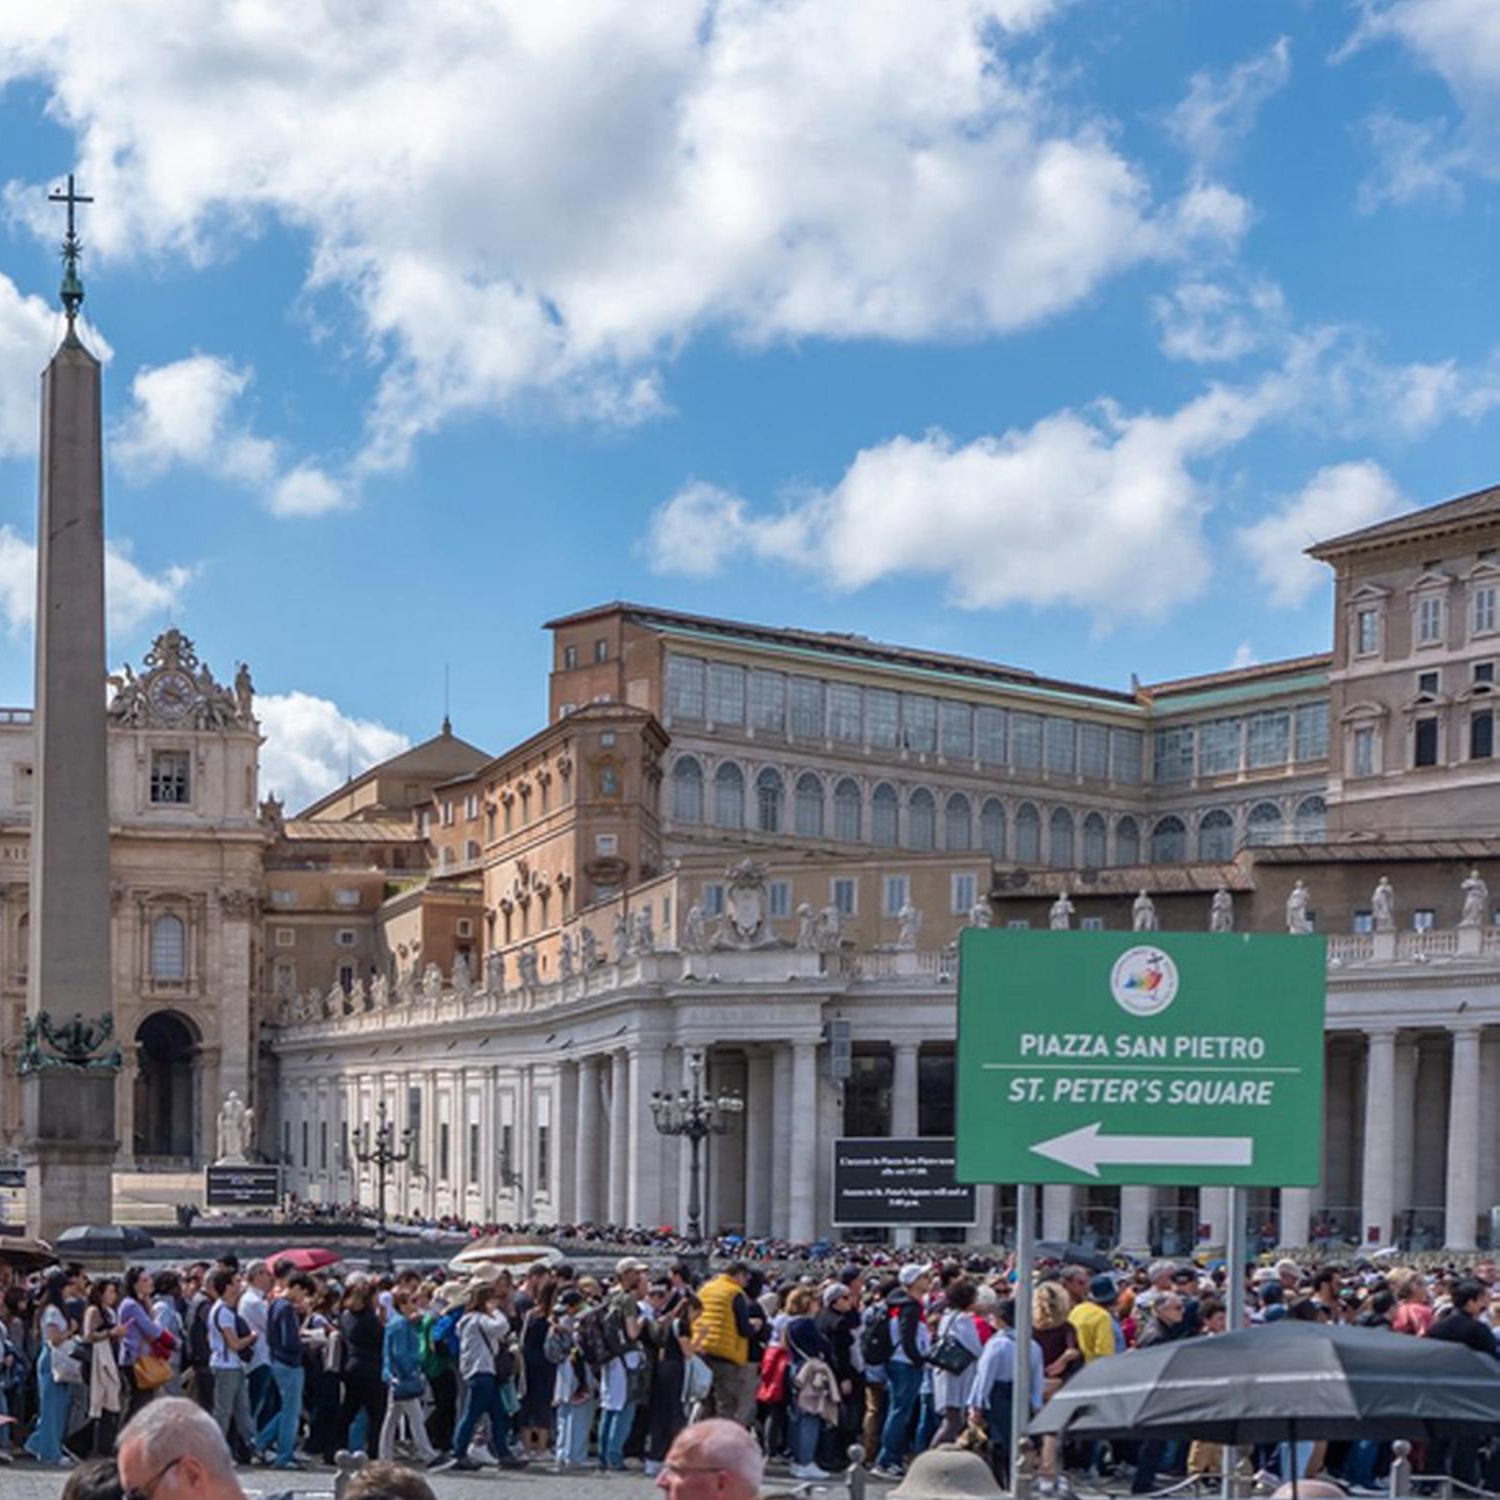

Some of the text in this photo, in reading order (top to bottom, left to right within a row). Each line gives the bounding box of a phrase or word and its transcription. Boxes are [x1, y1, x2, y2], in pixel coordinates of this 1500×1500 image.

[1020, 1034, 1264, 1059] PIAZZA SAN PIETRO
[1008, 1078, 1274, 1105] ST. PETER'S SQUARE
